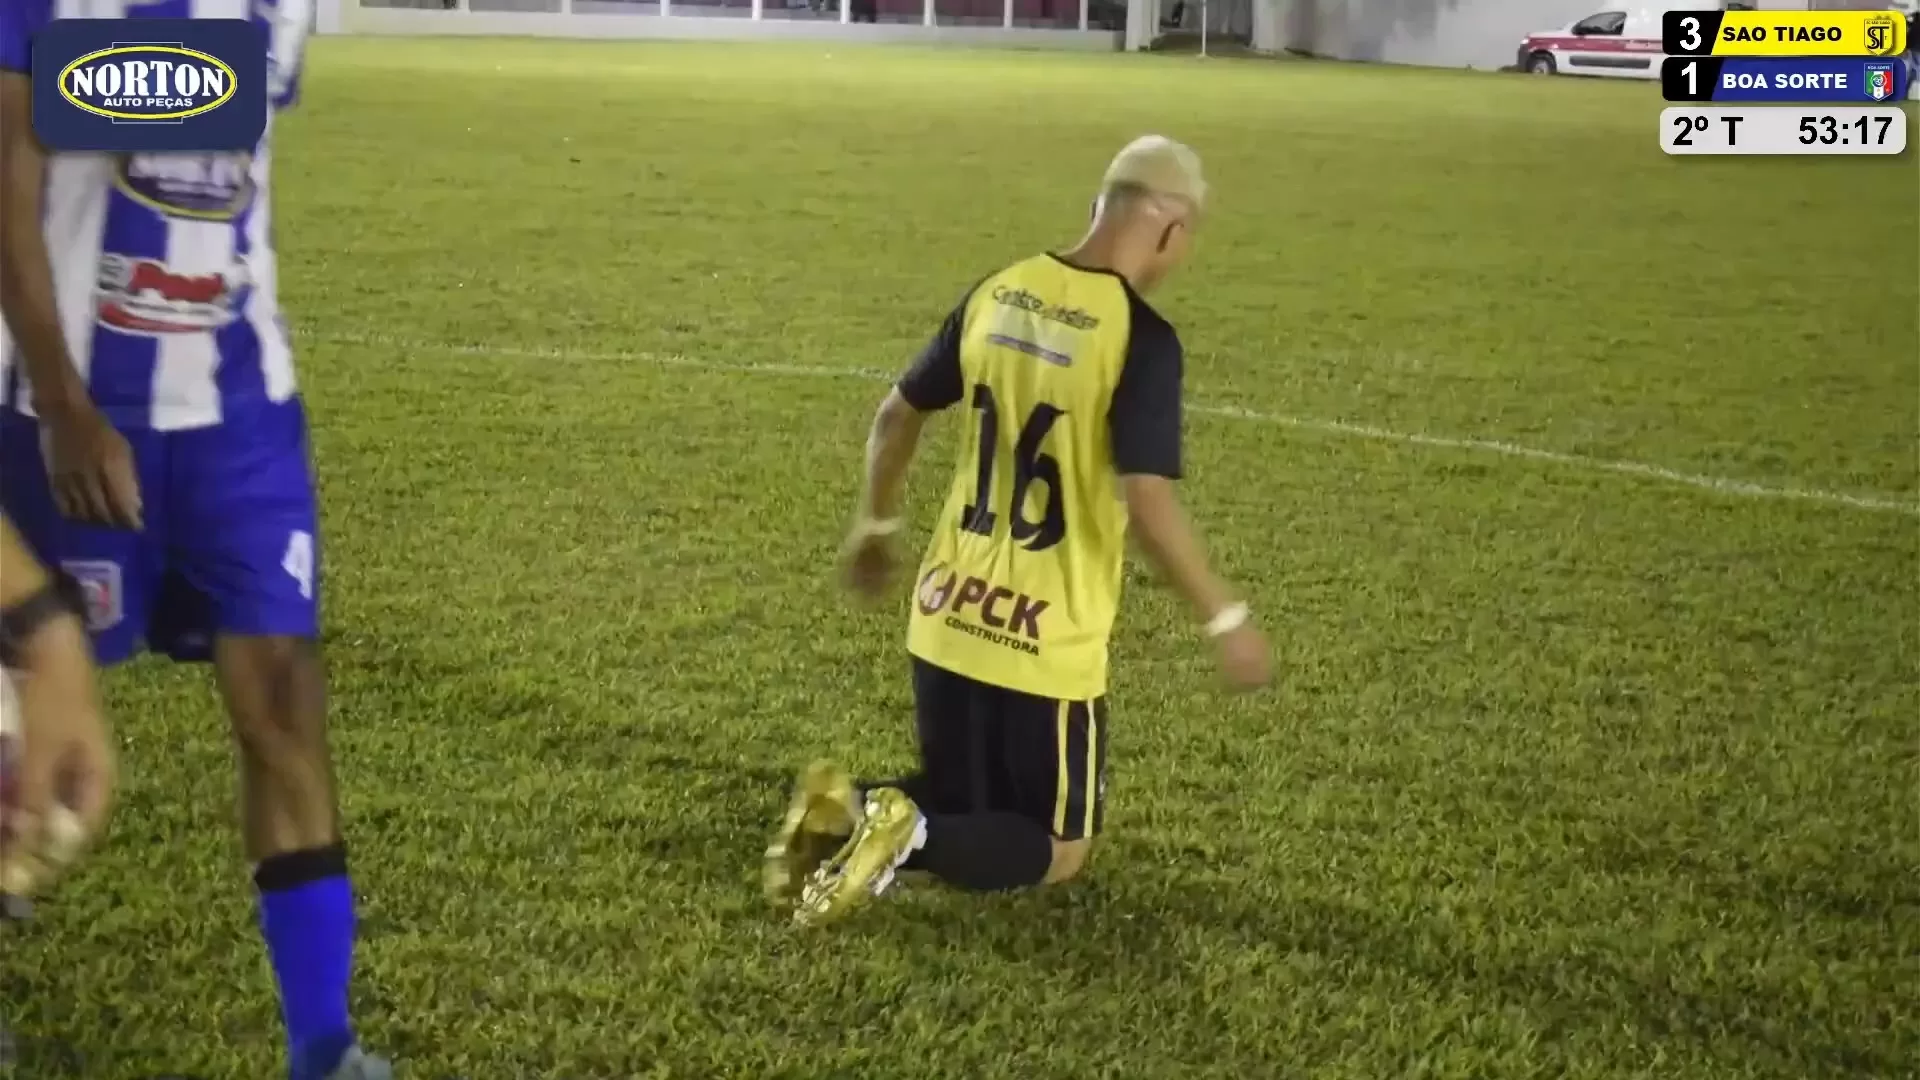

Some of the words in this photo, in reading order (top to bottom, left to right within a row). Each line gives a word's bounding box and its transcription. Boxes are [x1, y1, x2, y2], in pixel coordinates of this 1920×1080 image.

[961, 383, 1067, 551] 16
[944, 615, 1040, 657] CONSTRUTORA
[951, 576, 1051, 641] PCK
